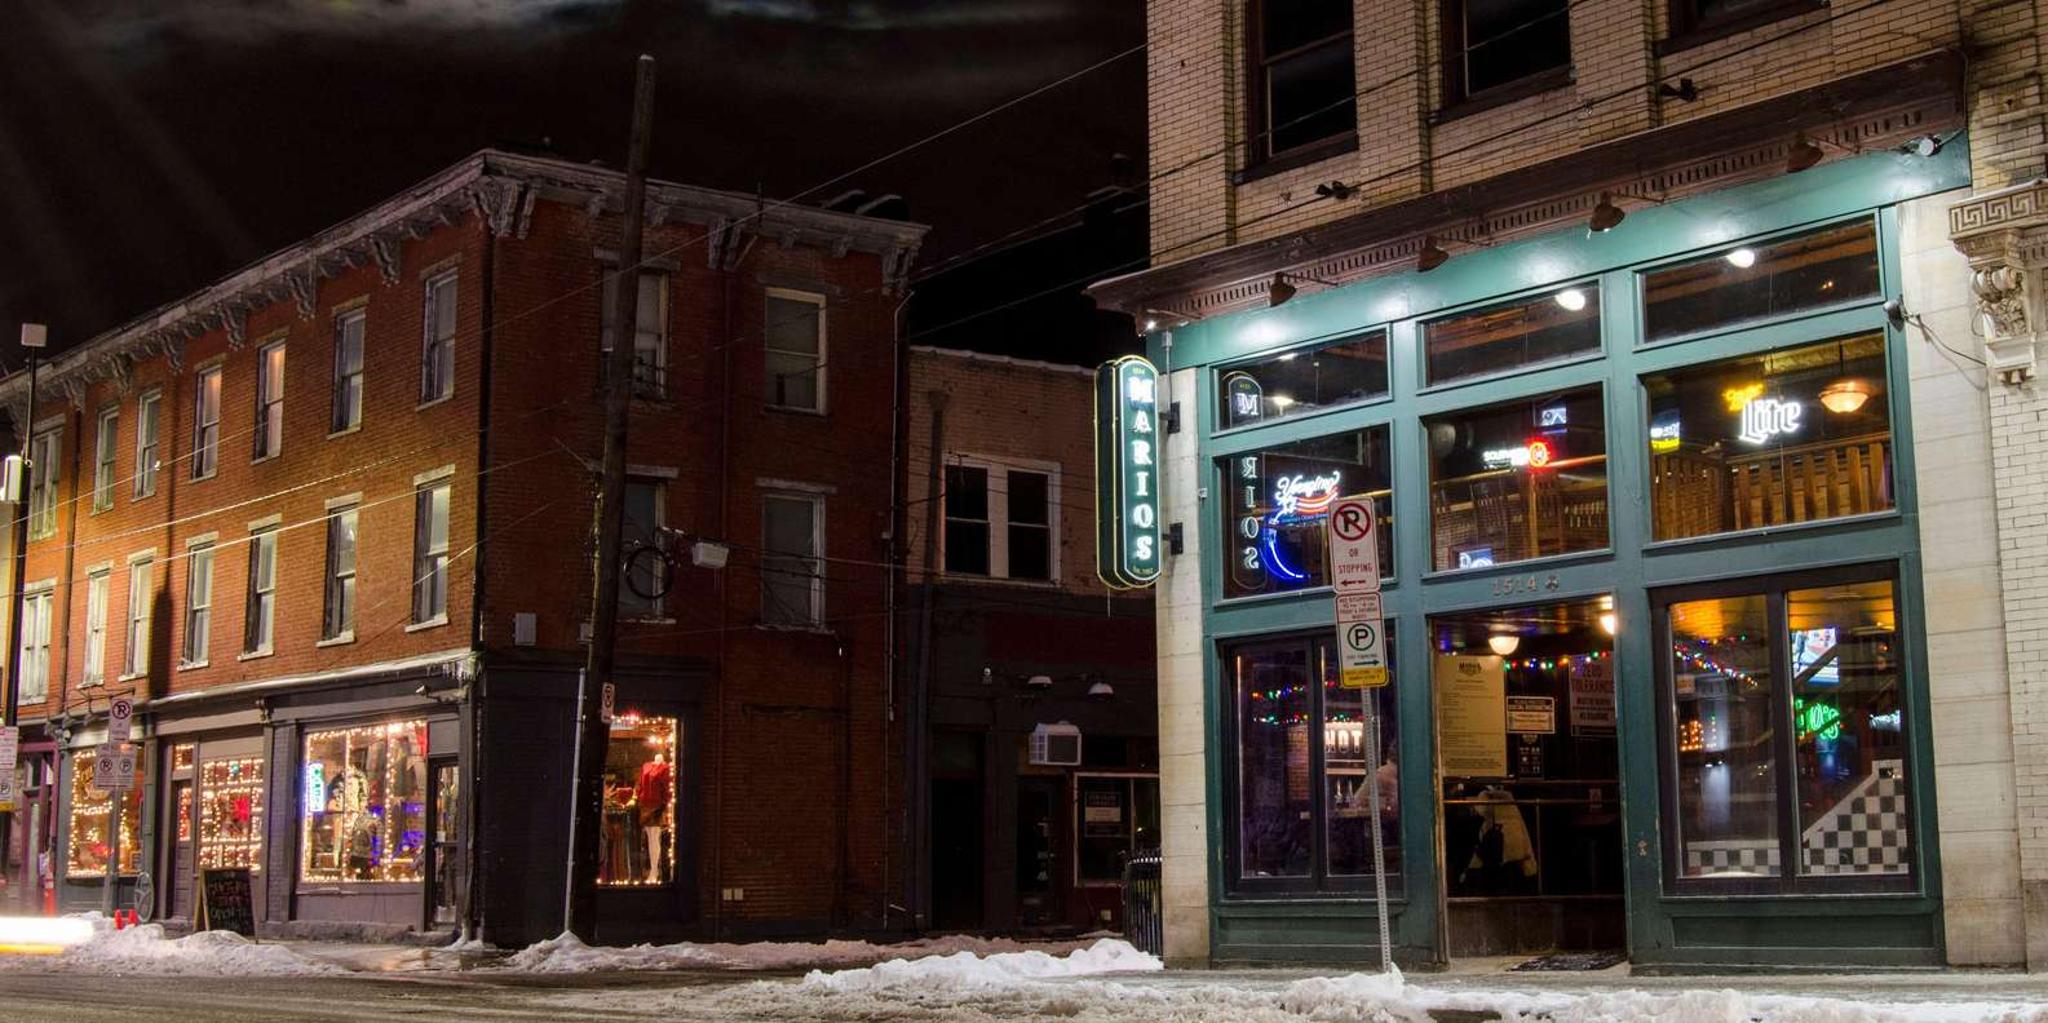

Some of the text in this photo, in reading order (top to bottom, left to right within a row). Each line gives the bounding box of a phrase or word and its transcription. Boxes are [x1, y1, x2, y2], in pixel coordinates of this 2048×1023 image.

[1738, 399, 1801, 444] Lite
[1128, 376, 1154, 561] MARIOS
[1348, 548, 1359, 558] OR
[1338, 562, 1373, 575] STOPPING
[1491, 575, 1538, 597] 1514
